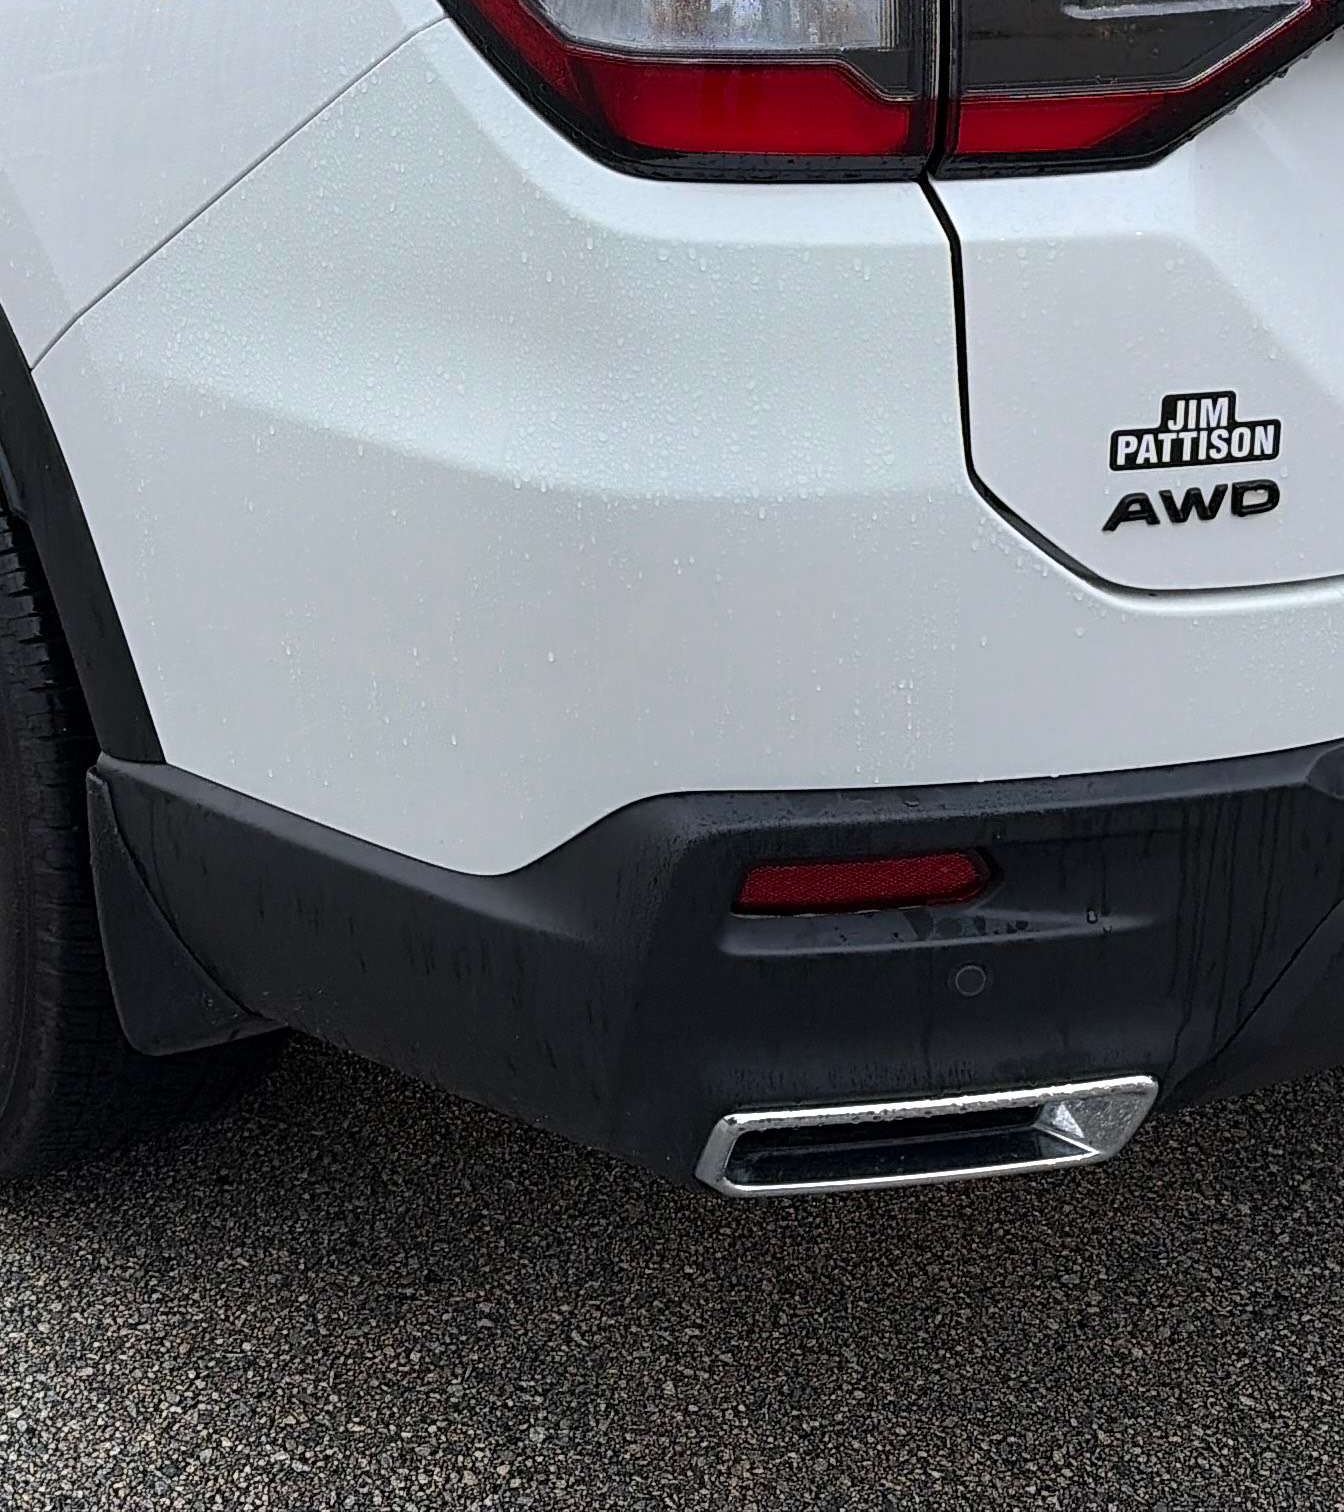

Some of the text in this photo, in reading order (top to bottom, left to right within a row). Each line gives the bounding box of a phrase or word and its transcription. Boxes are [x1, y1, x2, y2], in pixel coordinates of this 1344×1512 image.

[1167, 396, 1229, 432] JIM
[1116, 424, 1275, 466] PATTISON
[1102, 479, 1281, 532] AWD
